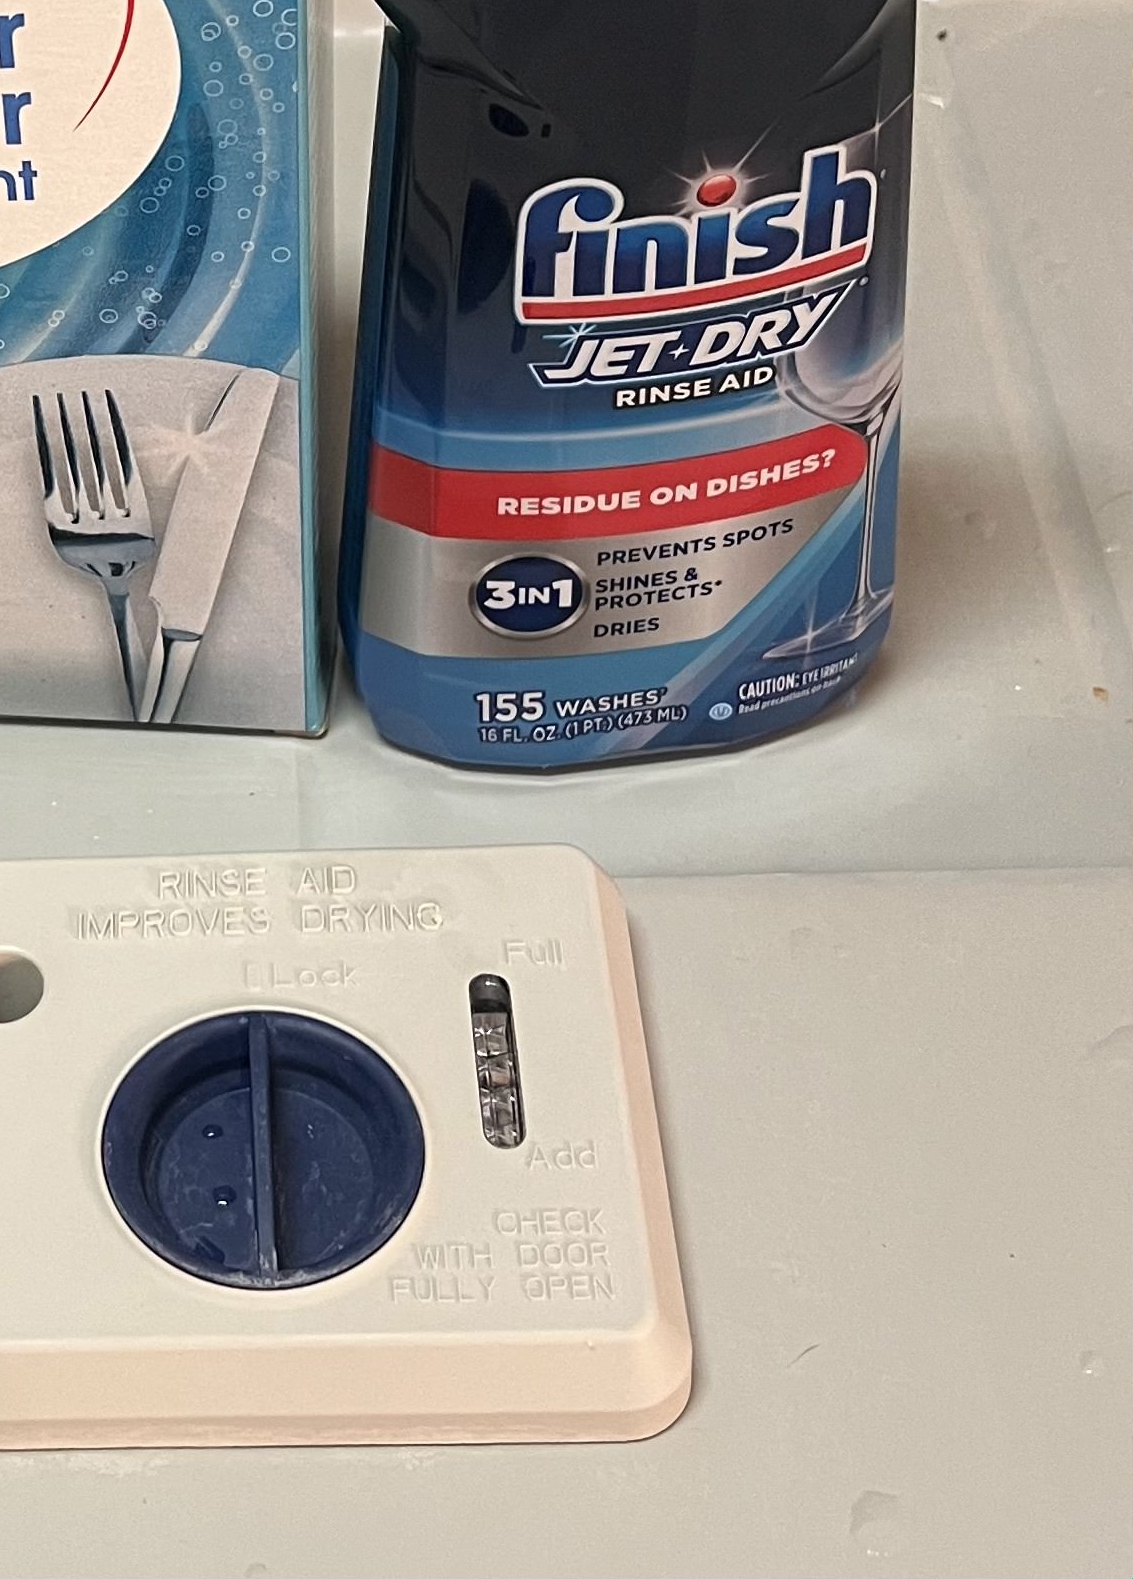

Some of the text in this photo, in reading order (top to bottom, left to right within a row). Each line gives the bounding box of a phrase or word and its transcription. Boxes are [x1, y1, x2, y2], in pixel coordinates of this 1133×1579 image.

[517, 145, 877, 305] finish
[616, 366, 774, 407] RINSE AID
[497, 448, 836, 516] RESIDUE ON DISHES?
[596, 518, 794, 566] PREVENTS SPOTS
[595, 567, 698, 593] SHINES &
[593, 617, 660, 638] DRIES
[738, 672, 800, 701] CAUTION:
[802, 668, 819, 685] EYE
[476, 691, 544, 722] 155
[480, 728, 498, 742] 16
[618, 711, 652, 729] (473
[657, 706, 687, 722] ML)
[158, 865, 357, 900] RINSE AID
[77, 902, 443, 941] IMPROVES DRYING
[504, 939, 565, 966] Full
[269, 960, 357, 989] Lock
[528, 1140, 599, 1170] Add
[495, 1208, 607, 1236] CHECK
[415, 1241, 612, 1270] WITH DOOR
[390, 1273, 617, 1304] FULLY OPEN
